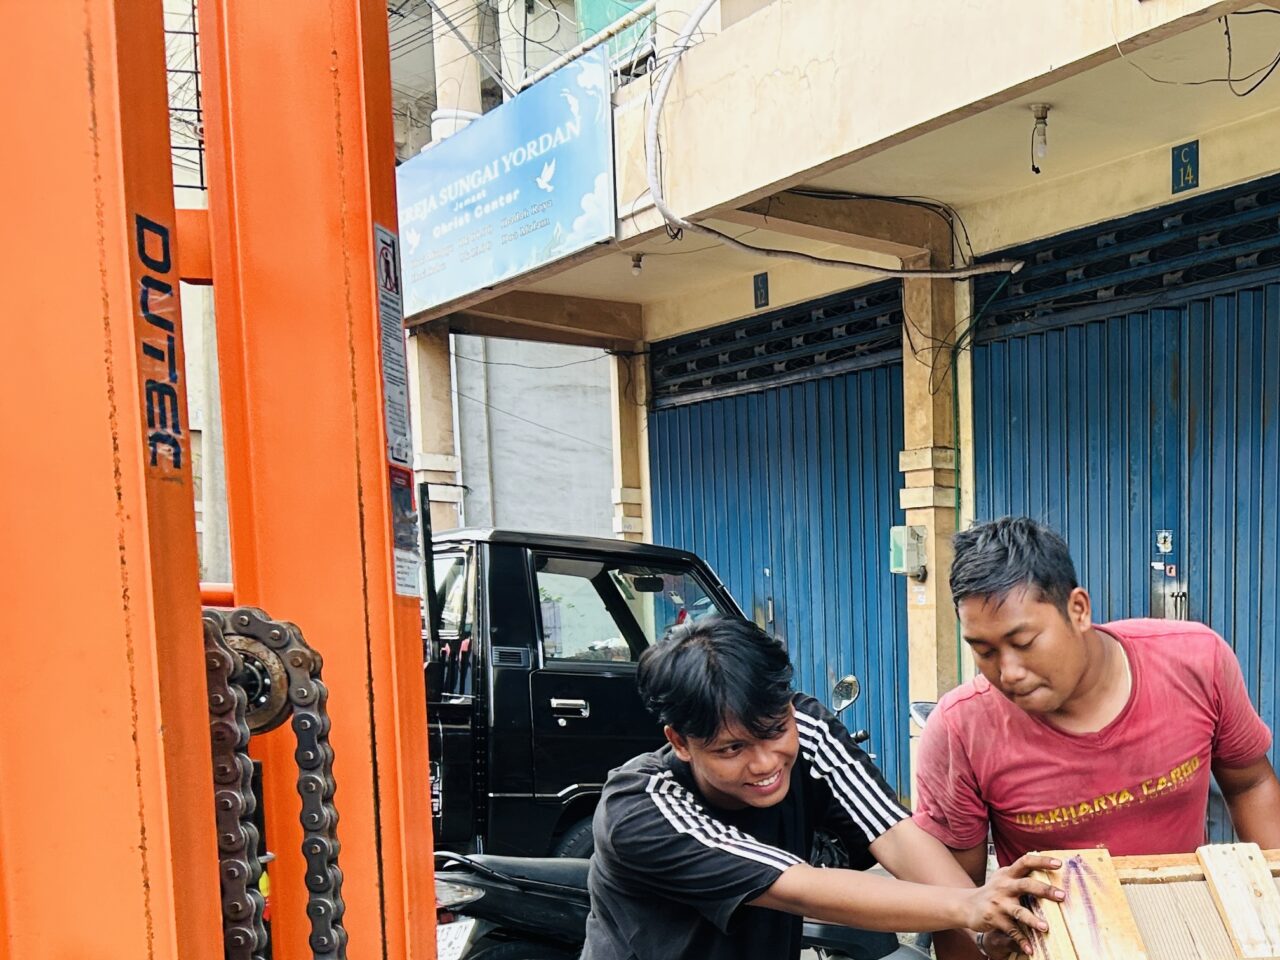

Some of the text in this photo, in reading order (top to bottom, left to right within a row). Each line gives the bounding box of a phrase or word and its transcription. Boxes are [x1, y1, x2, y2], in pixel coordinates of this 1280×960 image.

[401, 119, 582, 227] EREJA SUNGAI YORDAN
[1178, 164, 1194, 187] 14
[1181, 147, 1189, 163] C
[432, 213, 471, 238] Christ
[474, 190, 519, 217] Center
[136, 214, 182, 469] DUTEC
[1015, 756, 1201, 825] MAKHARYA CARGO
